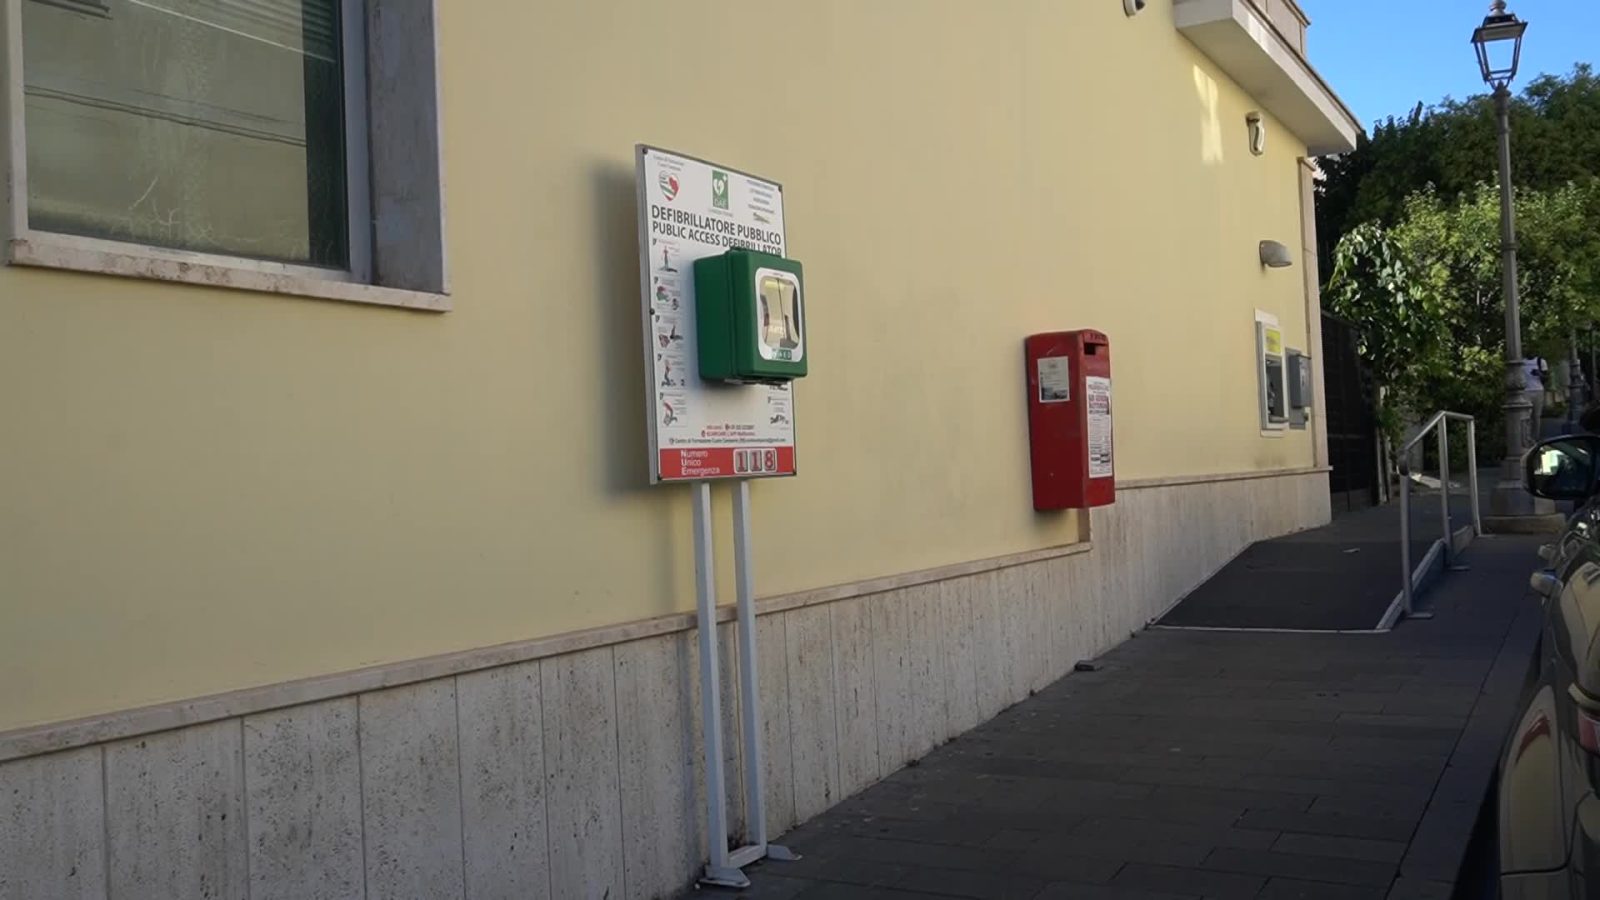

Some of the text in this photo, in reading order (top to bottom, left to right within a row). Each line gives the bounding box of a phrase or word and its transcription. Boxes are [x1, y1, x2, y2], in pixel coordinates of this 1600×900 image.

[652, 204, 781, 245] DEFIBRILLATORE PUBBLICO
[652, 221, 686, 239] PUBLIC
[688, 229, 720, 246] ACCESS
[680, 449, 708, 458] Numero
[735, 450, 775, 472] 118
[681, 458, 701, 466] Unico
[681, 466, 720, 477] Emergenza
